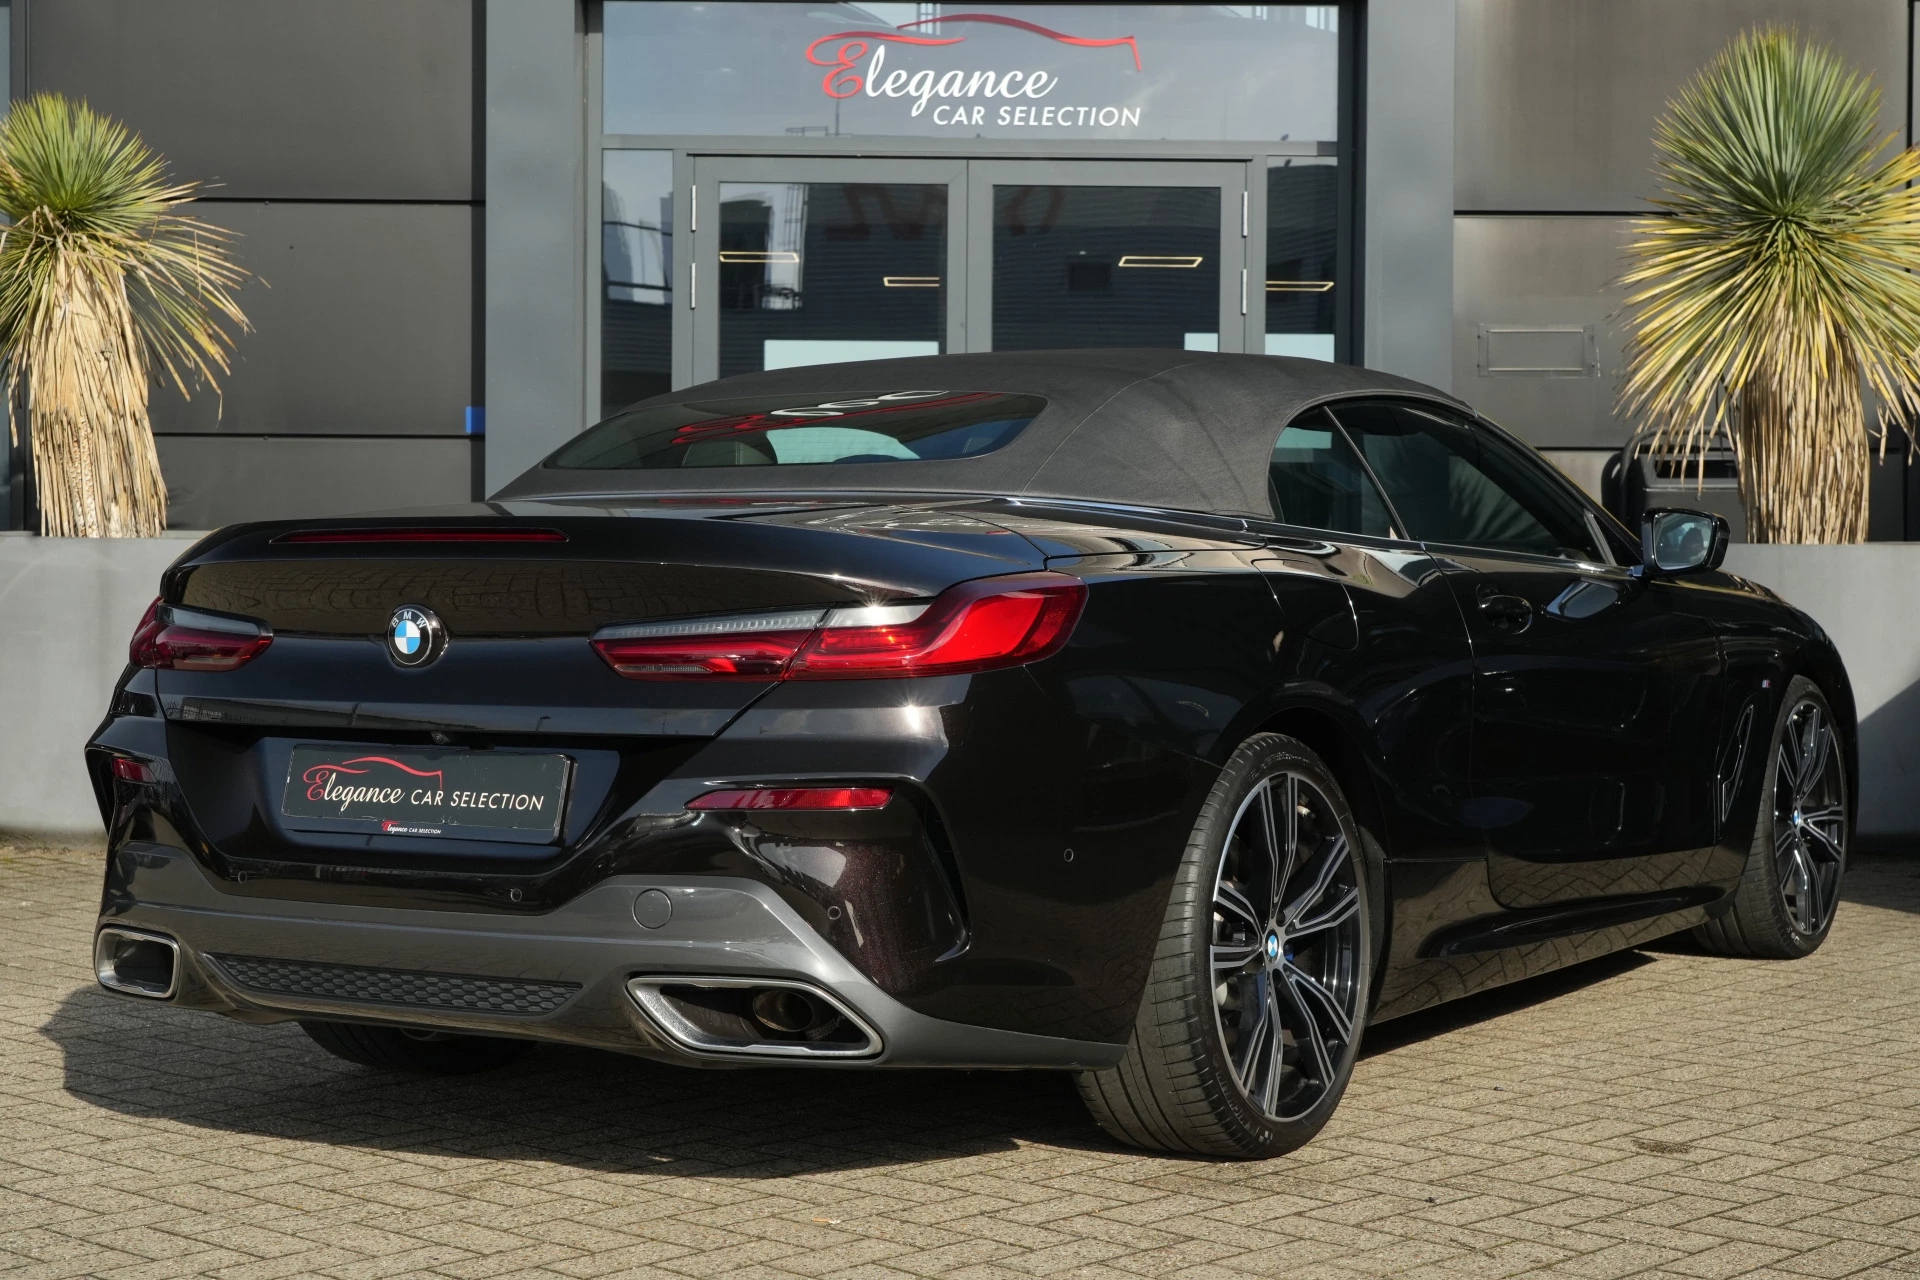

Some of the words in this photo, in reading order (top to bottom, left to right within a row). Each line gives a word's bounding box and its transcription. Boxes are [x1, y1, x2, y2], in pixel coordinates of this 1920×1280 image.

[806, 32, 1058, 117] Elegance
[933, 105, 985, 126] CAR
[997, 106, 1141, 127] SELECTION
[391, 611, 427, 628] BMW
[304, 764, 405, 812] Elegance
[410, 789, 444, 806] CAR
[450, 790, 545, 811] SELECTION
[382, 821, 408, 834] Elegance
